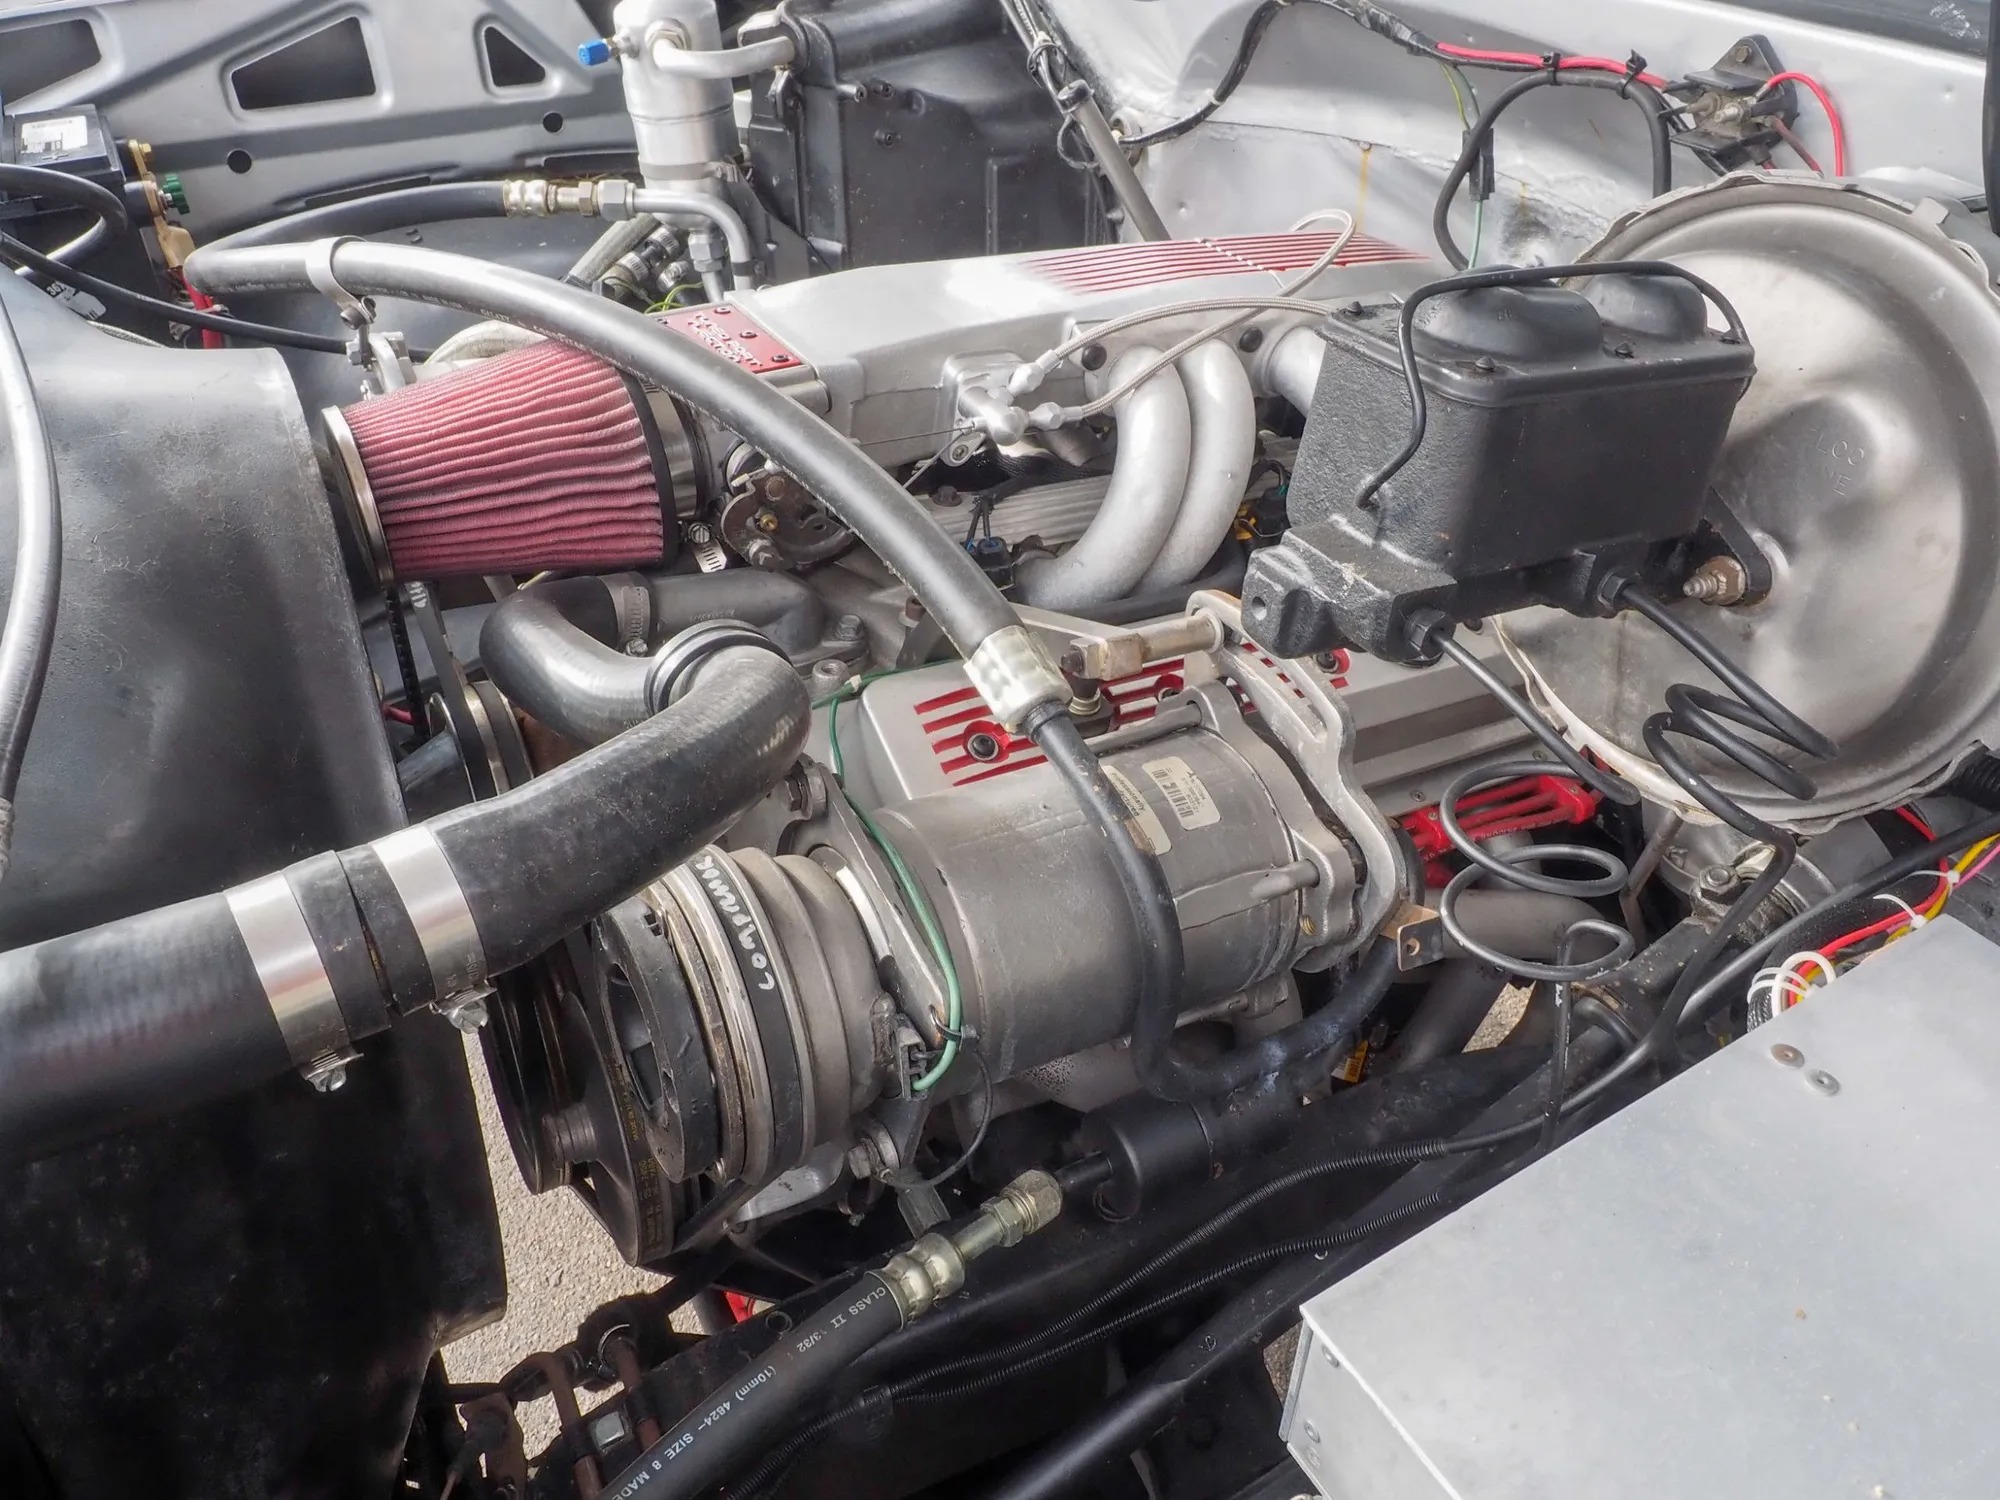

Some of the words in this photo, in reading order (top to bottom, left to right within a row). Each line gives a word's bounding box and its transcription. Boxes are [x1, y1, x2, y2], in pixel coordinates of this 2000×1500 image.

[848, 1286, 887, 1317] CLASS
[830, 1314, 848, 1330] II
[796, 1329, 826, 1353] 3/32
[734, 1365, 777, 1402] (10mm)
[664, 1433, 695, 1461] SIZE
[651, 1460, 663, 1472] 8
[610, 1471, 650, 1500] MADE
